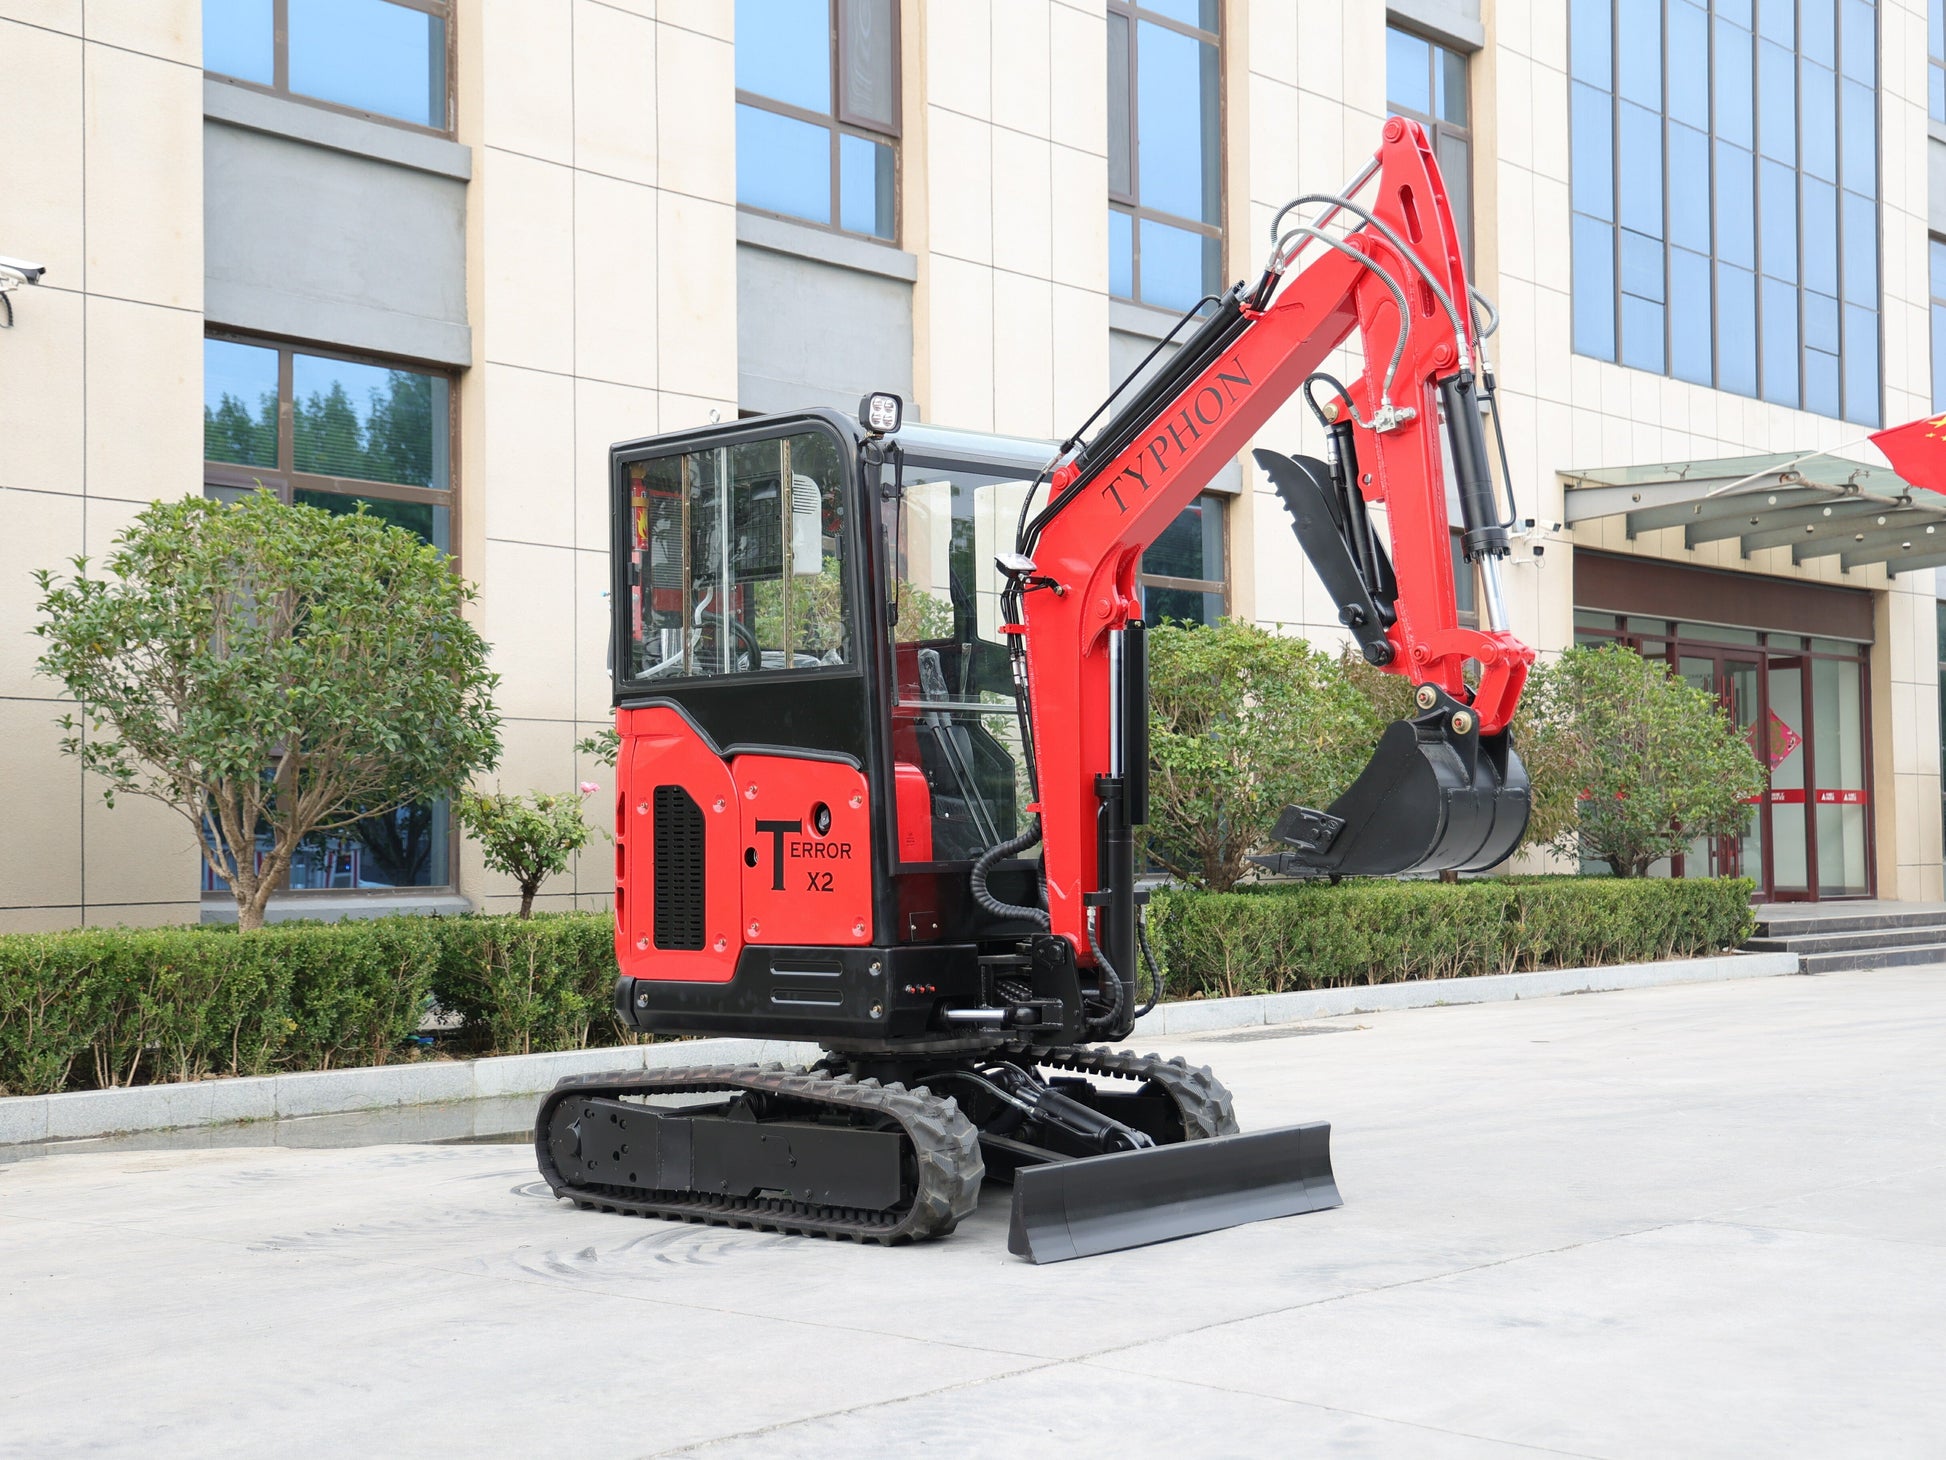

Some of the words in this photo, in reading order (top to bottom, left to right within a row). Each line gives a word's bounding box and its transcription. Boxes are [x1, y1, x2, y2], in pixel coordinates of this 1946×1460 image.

[1101, 354, 1253, 516] TYPHON
[755, 817, 852, 891] TERROR
[807, 872, 834, 892] X2
